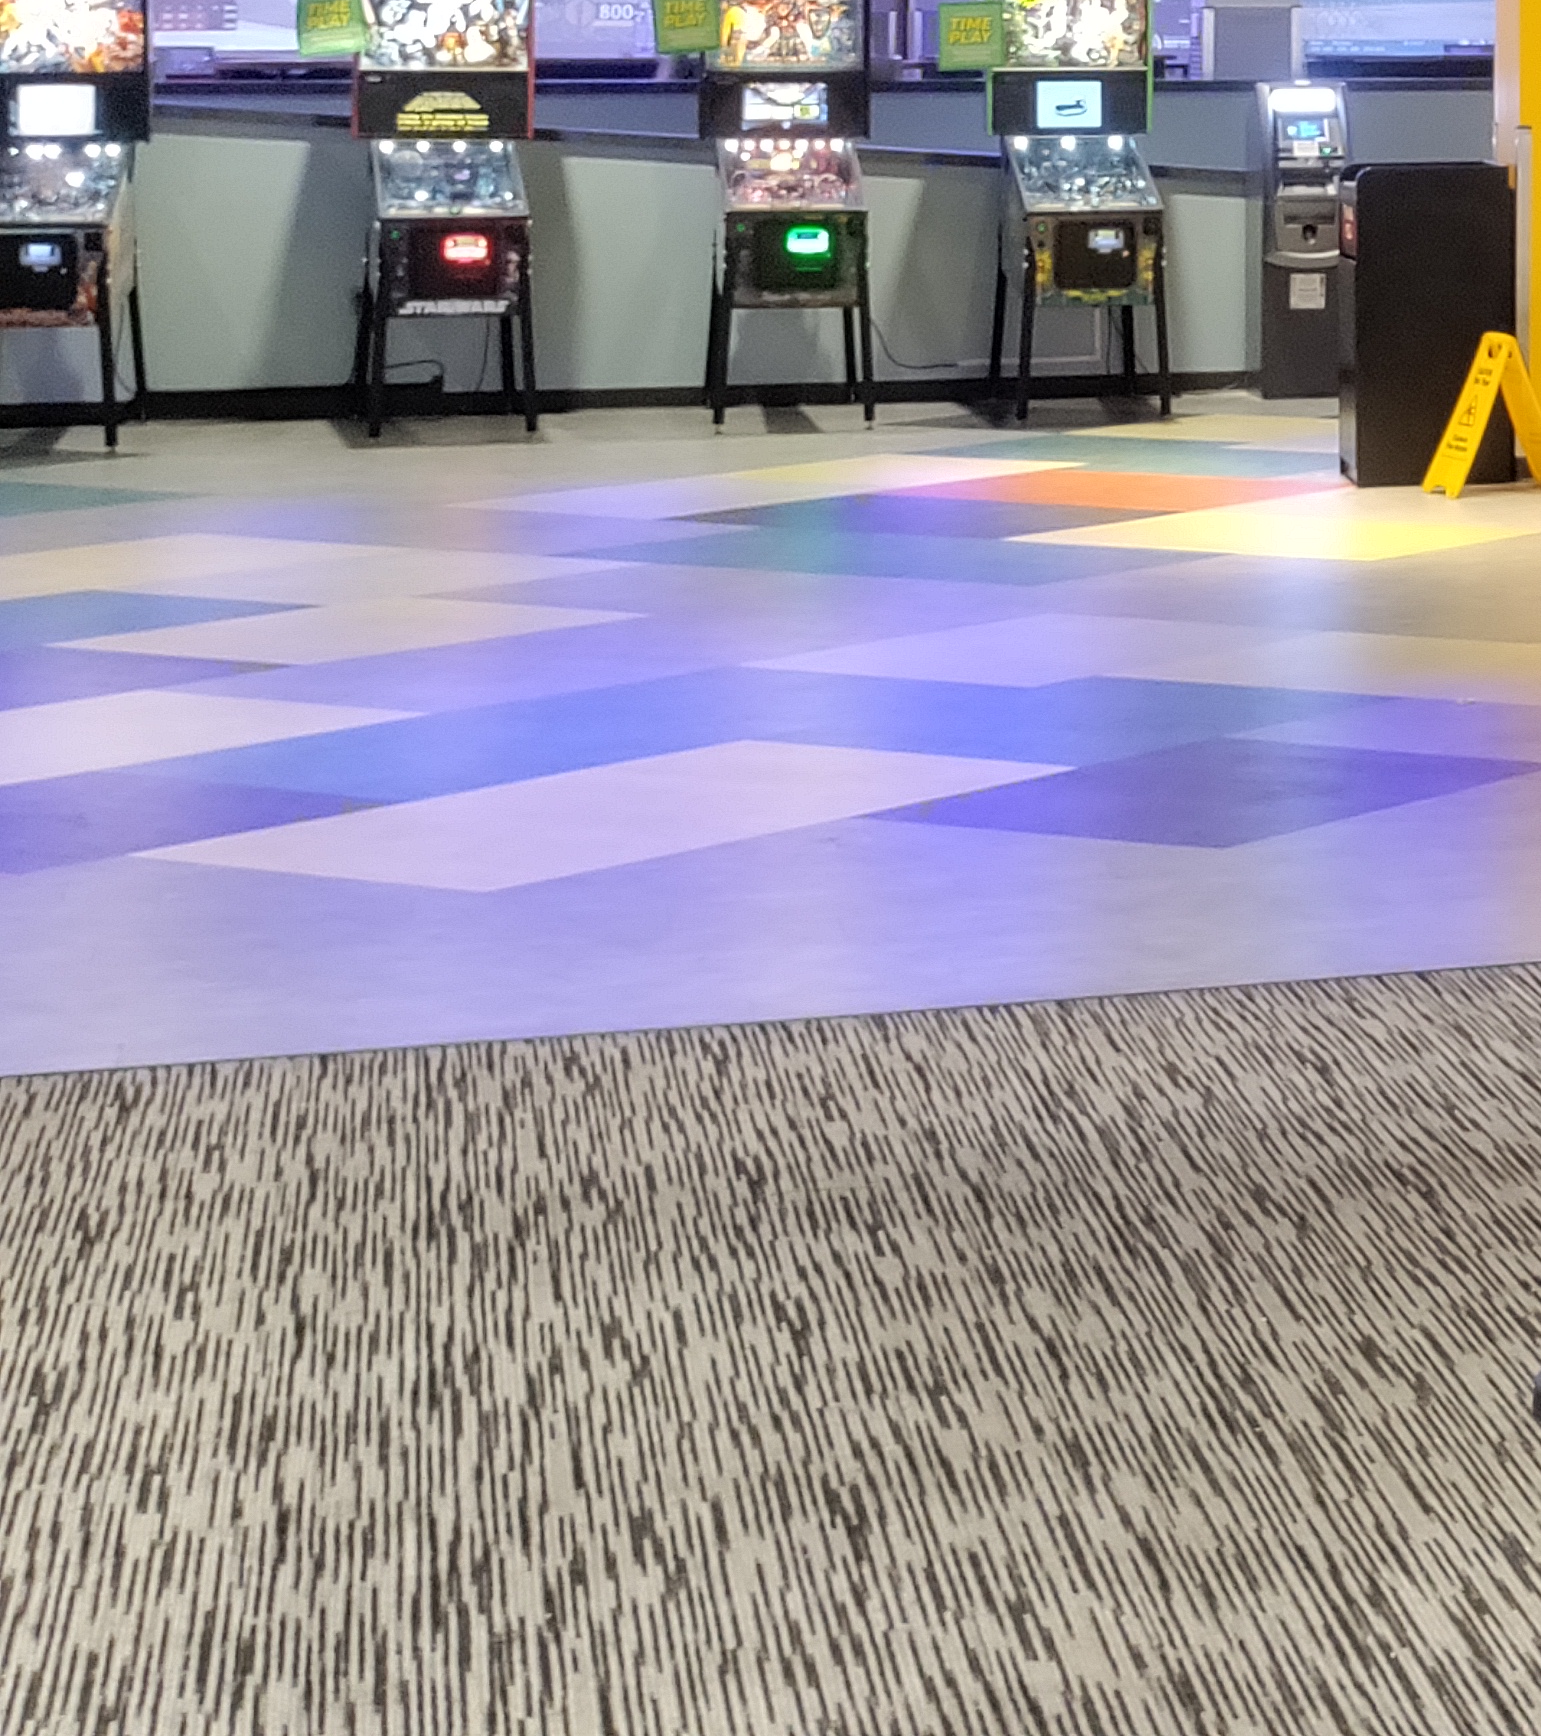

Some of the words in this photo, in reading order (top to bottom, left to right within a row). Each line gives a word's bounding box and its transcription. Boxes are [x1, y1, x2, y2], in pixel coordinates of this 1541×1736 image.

[308, 0, 350, 15] TIME
[664, 0, 705, 15] TIME
[306, 13, 350, 29] PLAY
[663, 13, 706, 28] PLAY
[951, 17, 991, 31] TIME
[948, 29, 992, 45] PLAY
